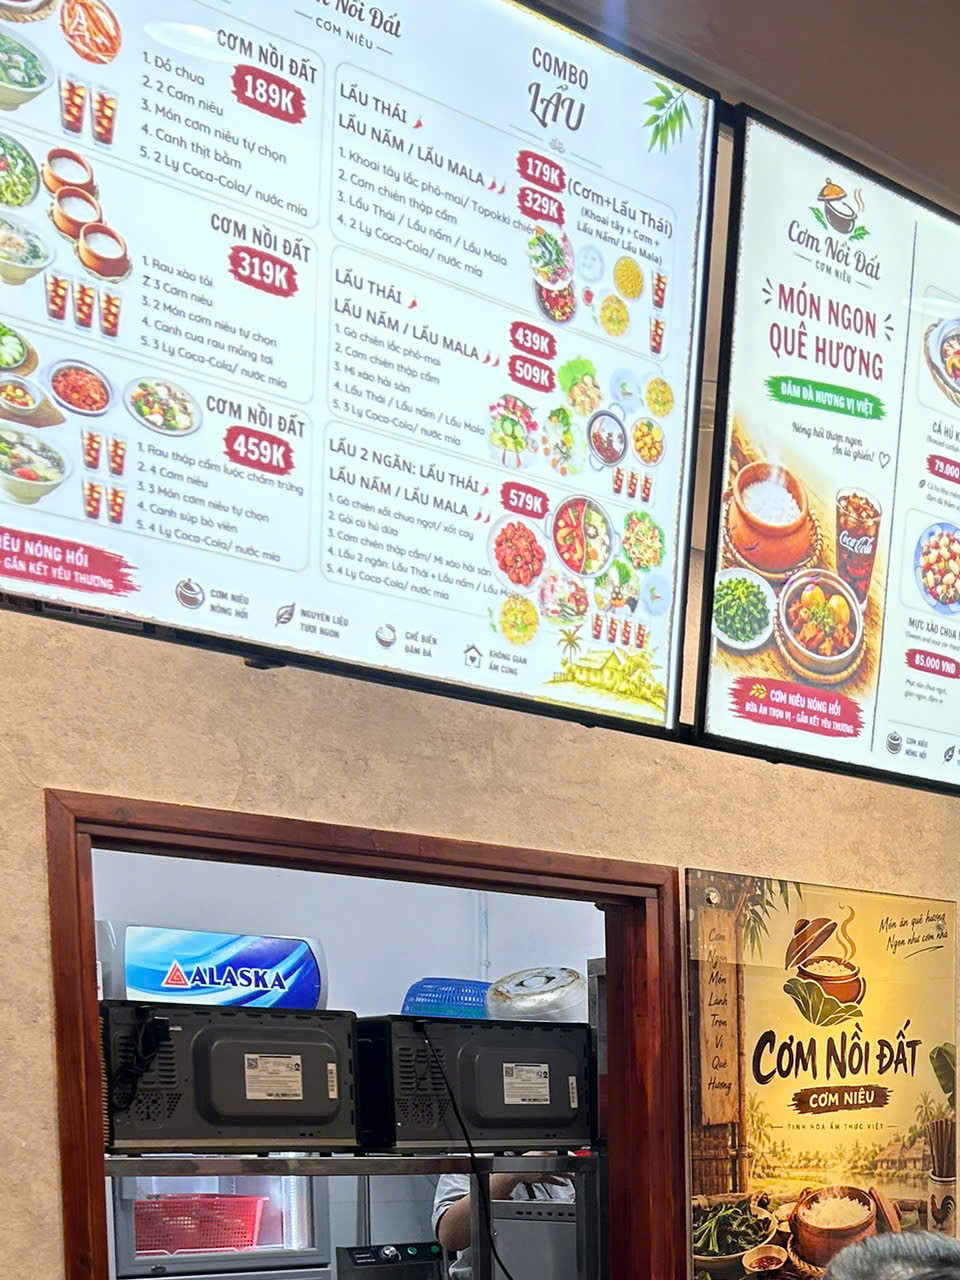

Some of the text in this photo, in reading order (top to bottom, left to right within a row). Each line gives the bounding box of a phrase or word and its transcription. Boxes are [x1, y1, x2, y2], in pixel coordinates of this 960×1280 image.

[346, 30, 373, 49] NIÊU
[217, 29, 317, 84] CƠM NỒI ĐẤT
[244, 74, 294, 114] 189K
[528, 46, 588, 131] COMBO LẨU
[372, 96, 407, 123] THÁI
[154, 151, 162, 164] 2
[165, 155, 180, 173] Ly
[286, 200, 308, 217] mía
[526, 157, 560, 187] 179K
[524, 189, 559, 219] 329K
[211, 213, 311, 264] CƠM NỒI ĐẤT
[788, 219, 881, 281] Cơm Nồi Đất
[237, 251, 288, 290] 319K
[778, 281, 876, 339] MÓN NGON
[514, 327, 550, 354] 439K
[769, 320, 884, 381] QUÊ HƯƠNG
[514, 361, 549, 387] 509K
[206, 394, 306, 438] CƠM NỒI ĐẤT
[233, 434, 286, 468] 459K
[509, 488, 543, 514] 579K
[24, 540, 62, 562] NÓNG
[879, 918, 897, 933] Món
[886, 936, 905, 953] Ngon
[190, 965, 287, 991] ALASKA
[752, 1019, 922, 1085] CƠM NỒI ĐẤT
[809, 1087, 875, 1108] CƠM NIÊU
